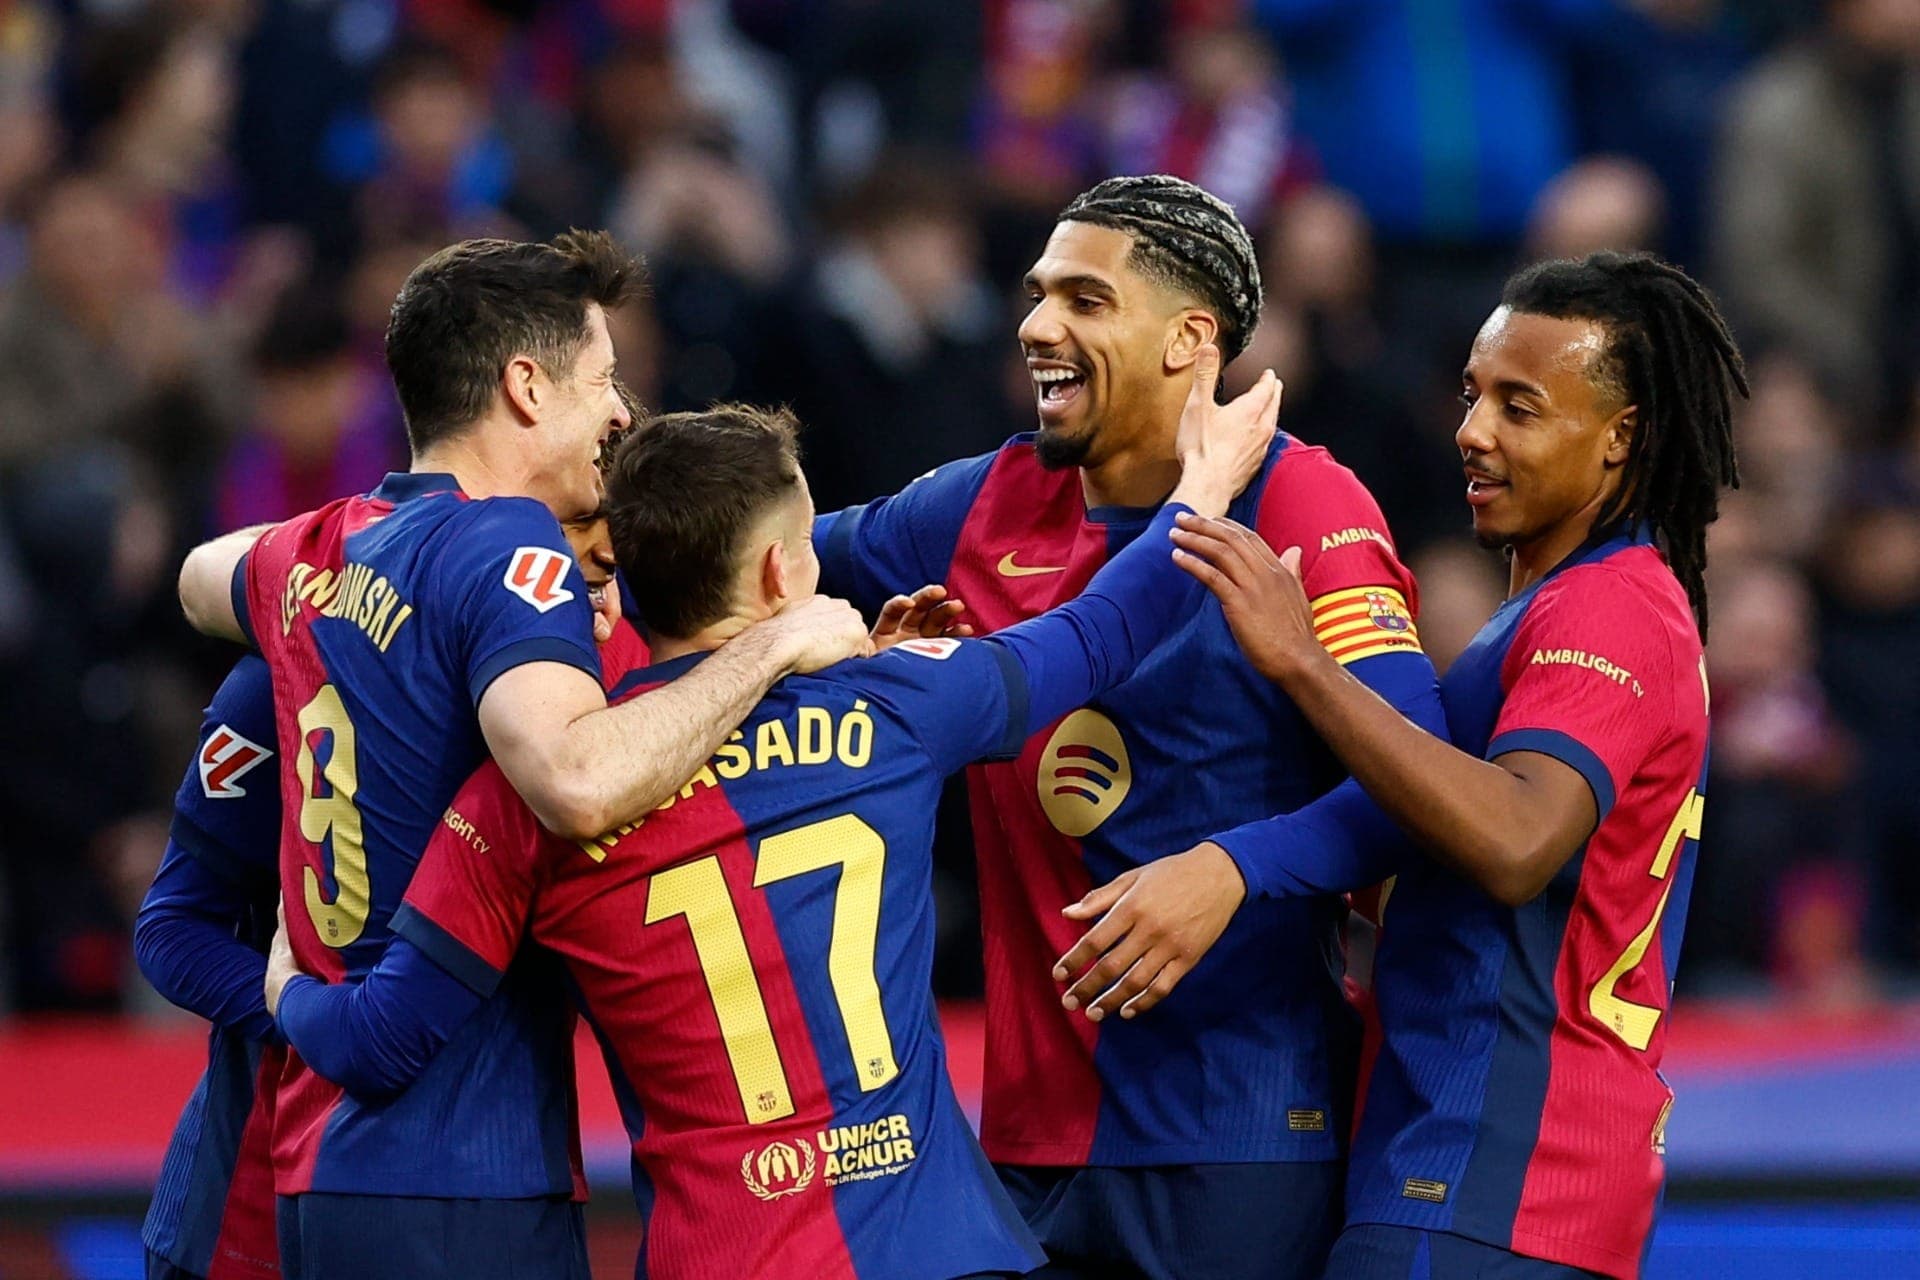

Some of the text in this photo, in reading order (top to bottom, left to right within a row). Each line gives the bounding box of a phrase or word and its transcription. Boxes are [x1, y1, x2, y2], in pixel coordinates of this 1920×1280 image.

[281, 562, 413, 653] LENDOWSKI
[1530, 648, 1631, 686] AMBILIGHT
[296, 683, 371, 948] 9
[643, 812, 900, 1126] 17
[816, 1114, 911, 1153] UNHCR
[823, 1138, 916, 1177] ACNUR
